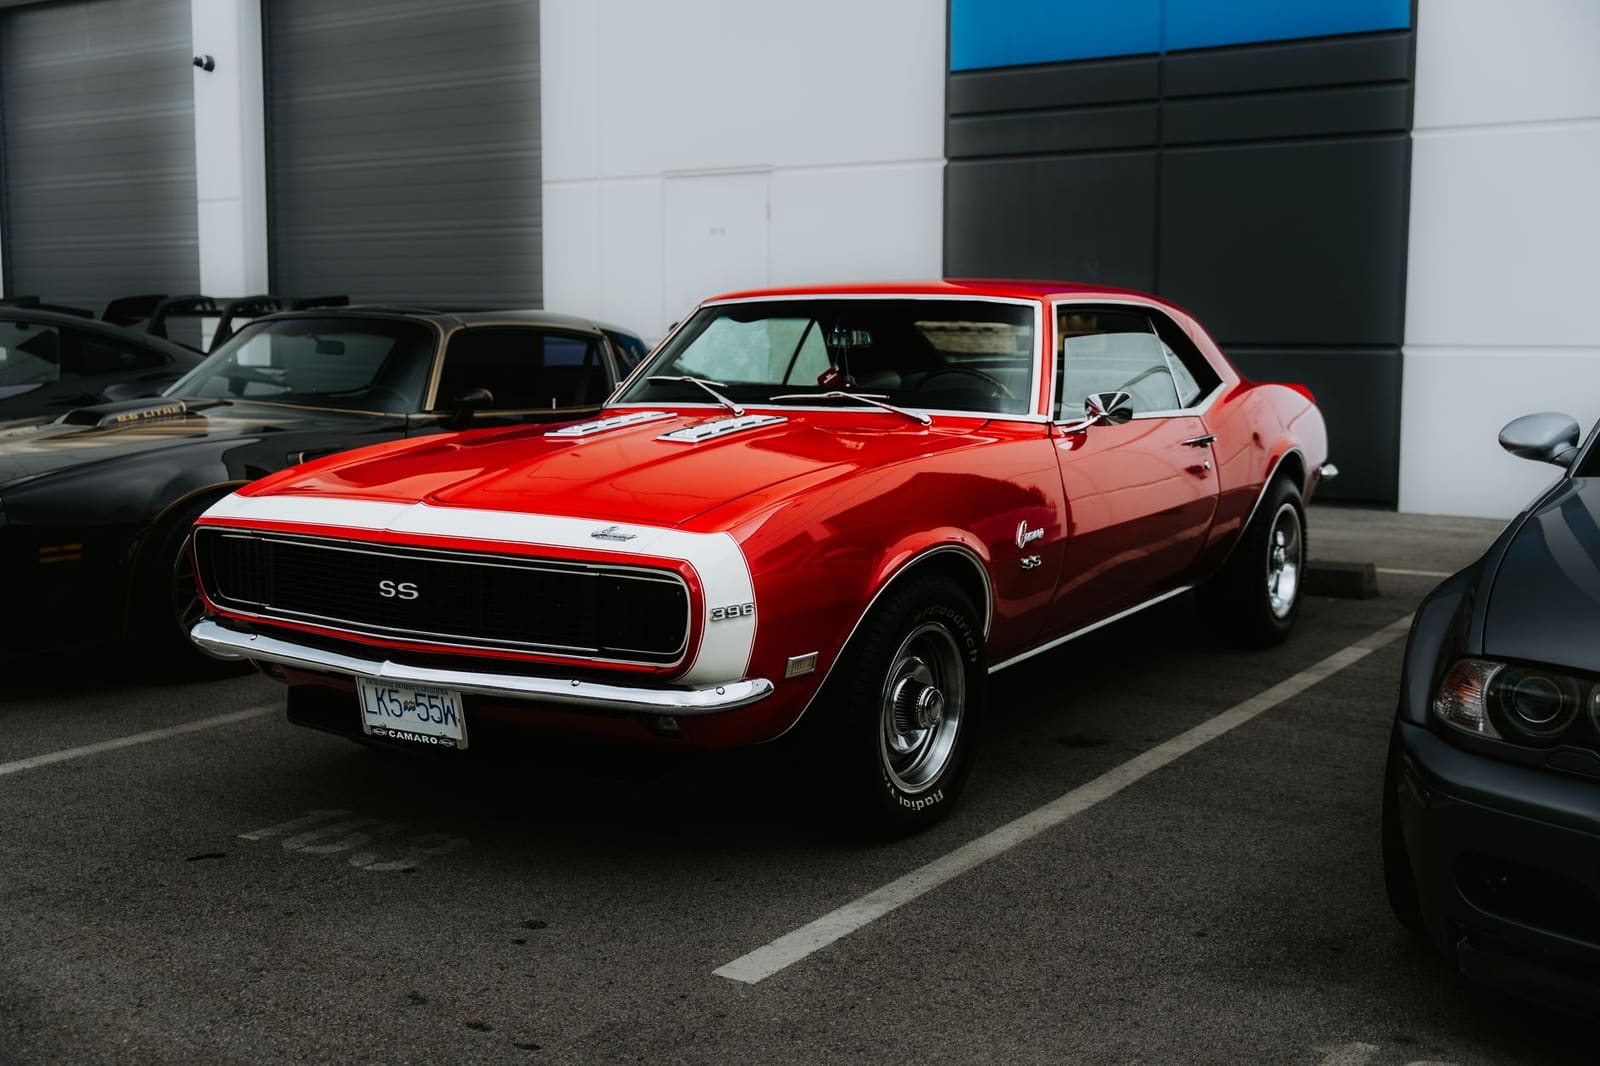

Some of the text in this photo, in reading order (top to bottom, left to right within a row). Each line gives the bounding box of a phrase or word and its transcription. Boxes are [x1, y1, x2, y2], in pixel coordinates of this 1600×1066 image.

[1020, 555, 1041, 569] SS
[379, 580, 419, 600] SS
[710, 602, 754, 622] 396
[362, 685, 403, 718] LK5
[414, 692, 458, 727] 55W
[388, 730, 438, 744] CAMARO
[899, 788, 944, 811] Radial
